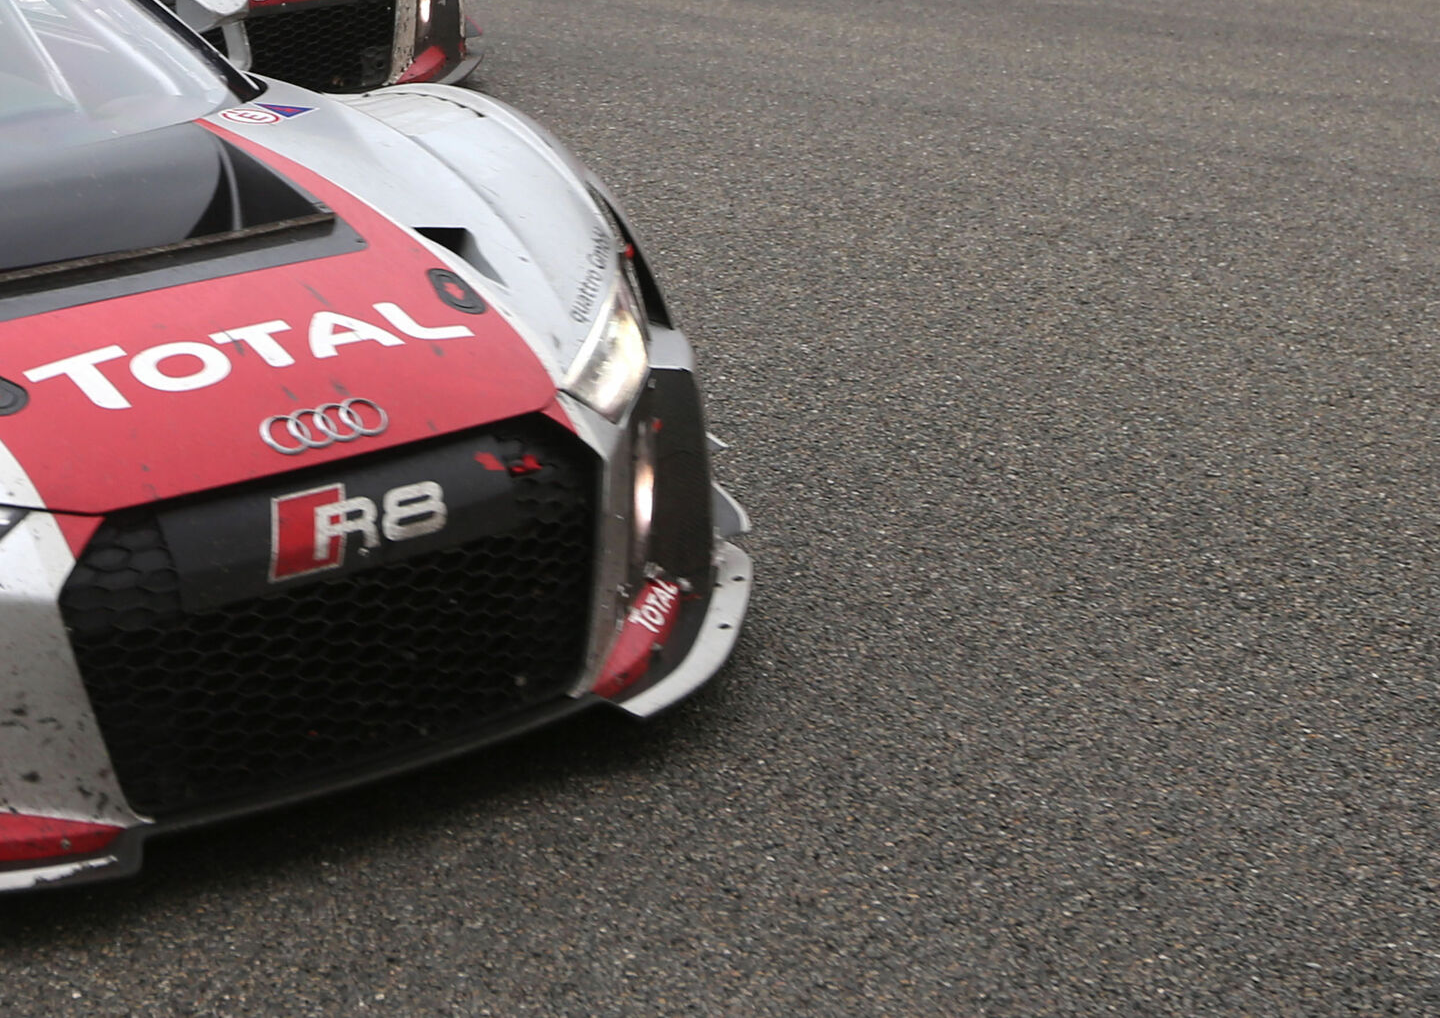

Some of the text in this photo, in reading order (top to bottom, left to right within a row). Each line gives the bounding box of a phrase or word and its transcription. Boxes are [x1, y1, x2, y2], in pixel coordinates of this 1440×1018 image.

[23, 301, 475, 410] TOTAL
[314, 481, 447, 561] R8
[627, 579, 679, 634] TOTAL
